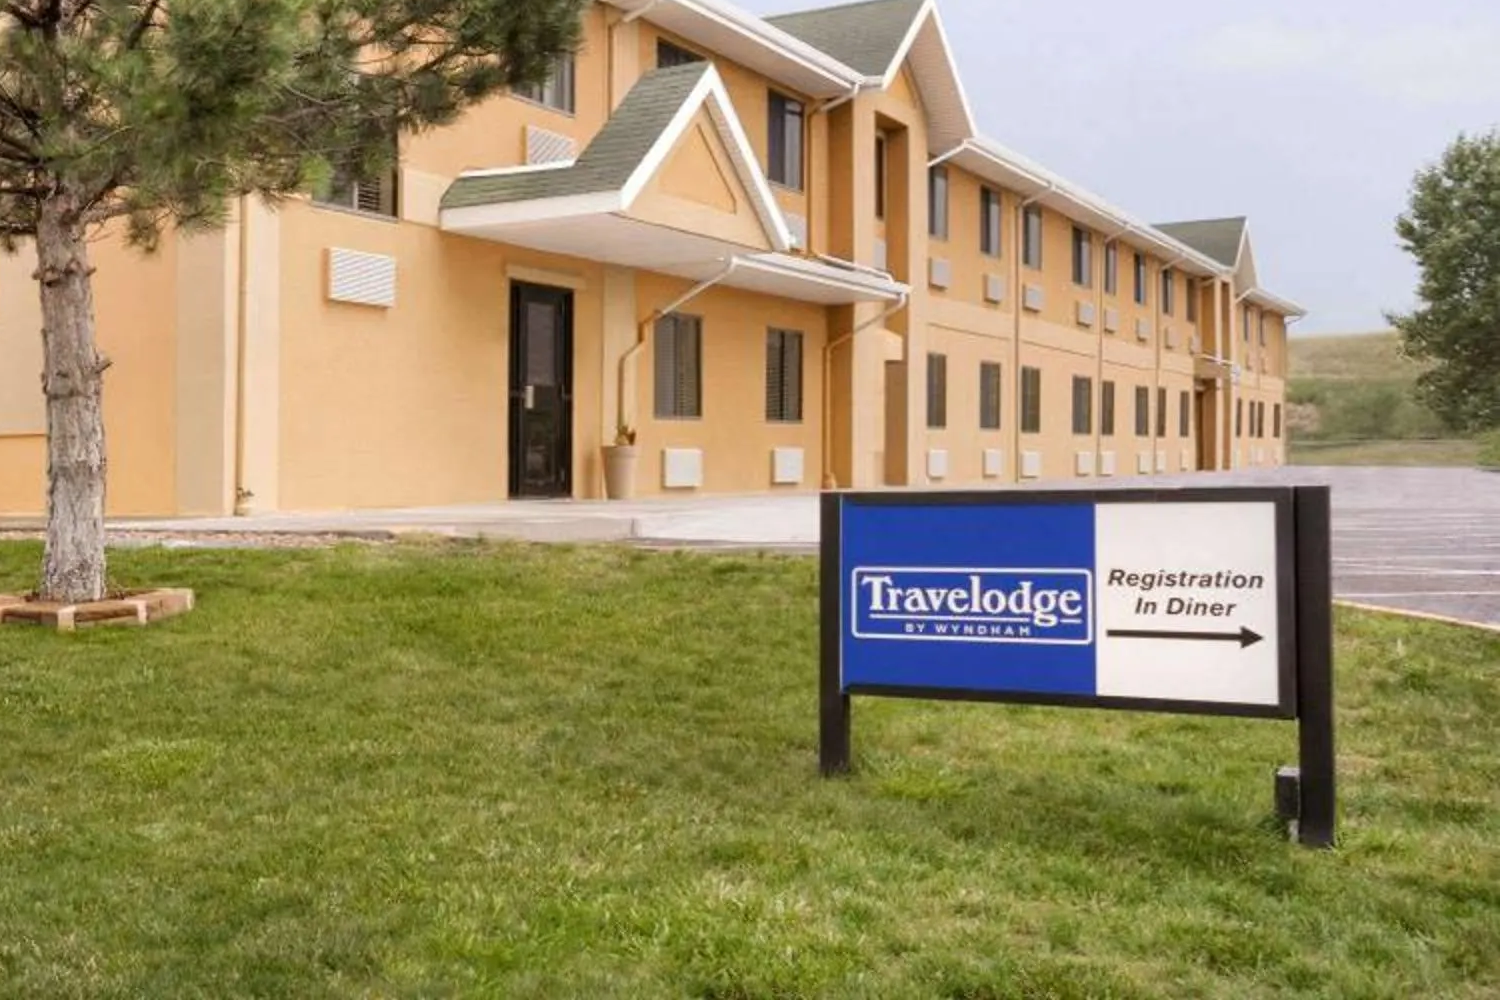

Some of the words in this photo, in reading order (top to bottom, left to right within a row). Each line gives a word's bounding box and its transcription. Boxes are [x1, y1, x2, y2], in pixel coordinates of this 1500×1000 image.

[1107, 568, 1264, 590] Registration
[861, 575, 1082, 627] Travelodge
[1134, 596, 1158, 616] In
[1165, 597, 1237, 618] Diner
[905, 622, 926, 633] BY
[934, 623, 1031, 636] WYNDHAM
